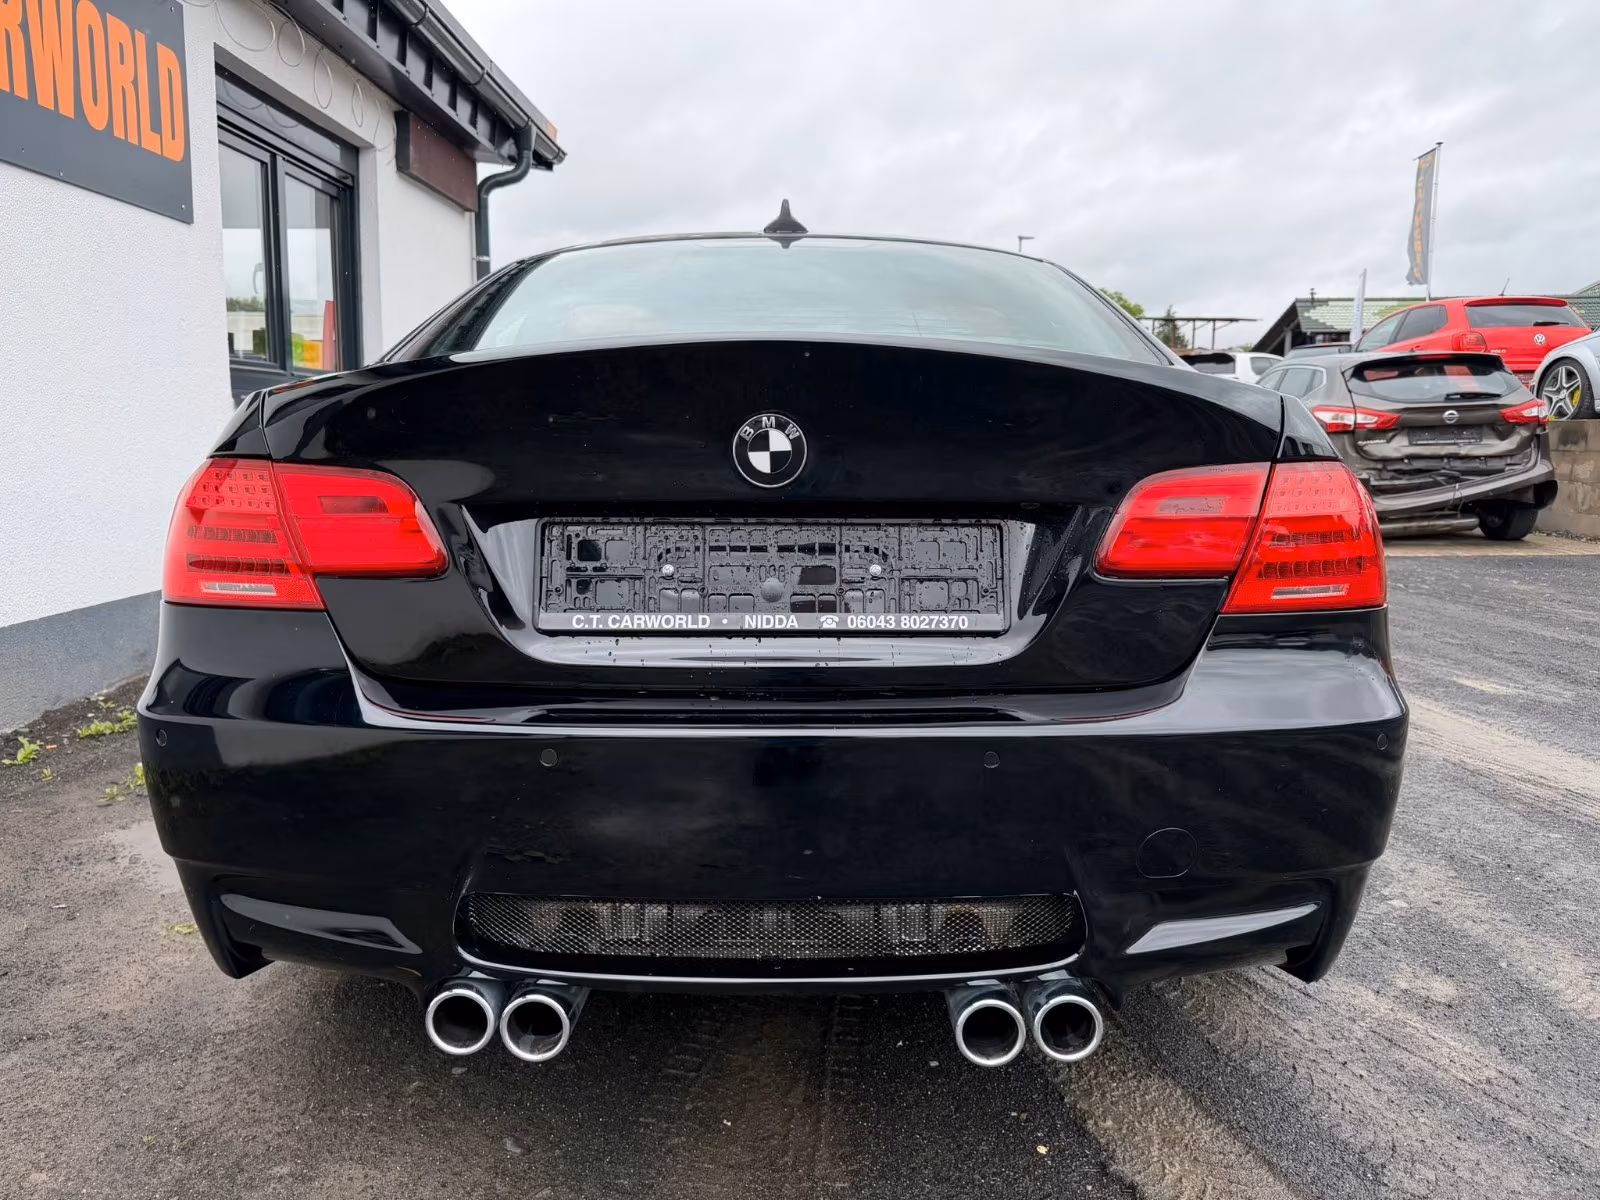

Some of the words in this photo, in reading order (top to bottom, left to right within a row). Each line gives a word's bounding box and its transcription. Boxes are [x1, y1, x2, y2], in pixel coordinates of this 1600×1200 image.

[740, 416, 800, 441] BMW
[571, 614, 603, 629] C.T.
[607, 614, 711, 629] CARWORLD
[744, 615, 799, 629] NIDDA
[847, 615, 896, 629] 06043
[900, 615, 969, 629] 8027370
